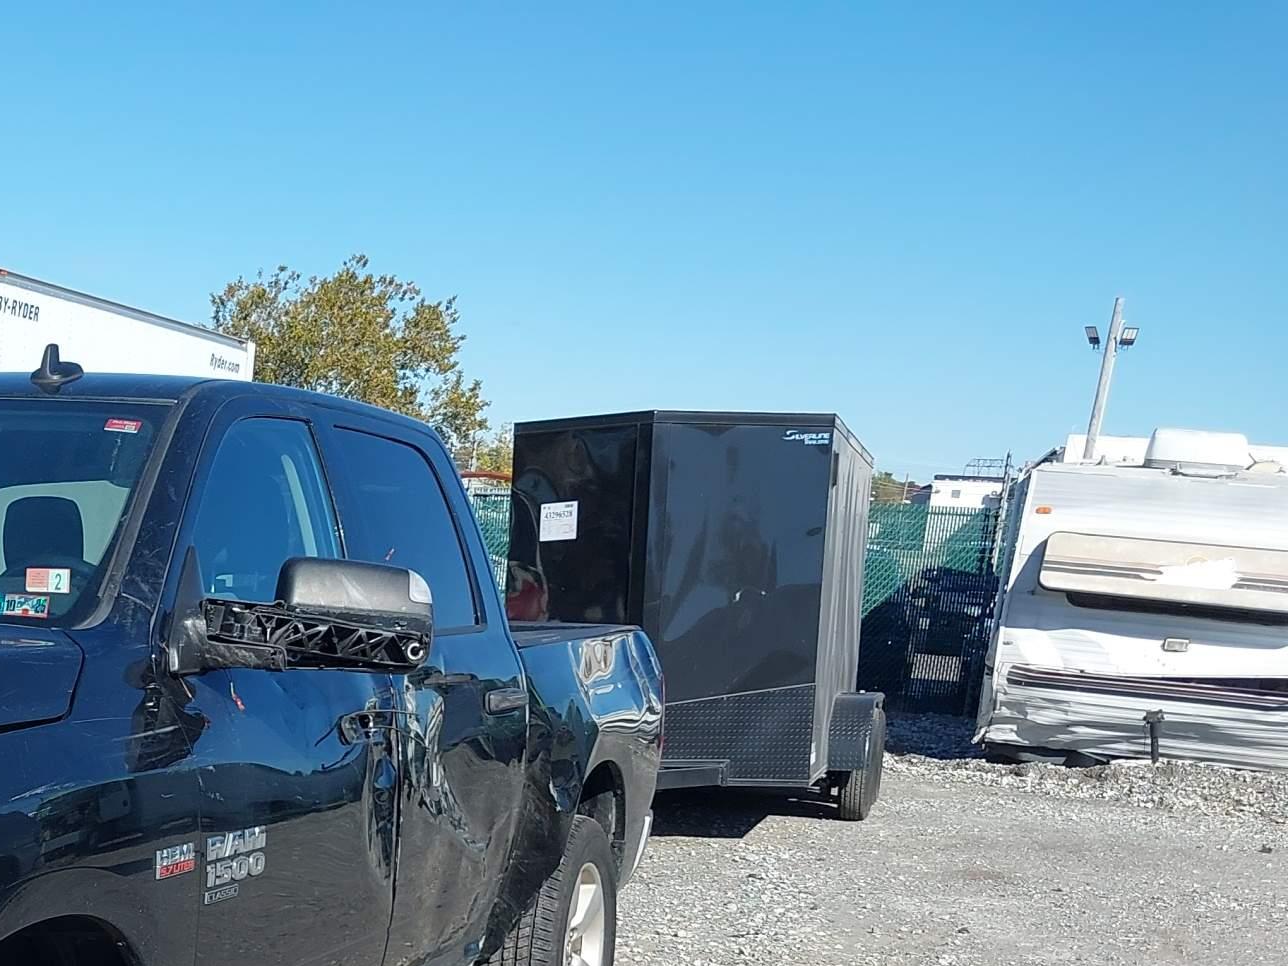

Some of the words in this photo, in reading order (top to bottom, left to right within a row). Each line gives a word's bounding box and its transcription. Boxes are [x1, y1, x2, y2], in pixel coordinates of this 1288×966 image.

[54, 573, 62, 590] 2
[6, 599, 16, 611] 10
[206, 826, 267, 861] RAM
[206, 852, 265, 887] 1500
[207, 885, 239, 902] CLASSIC
